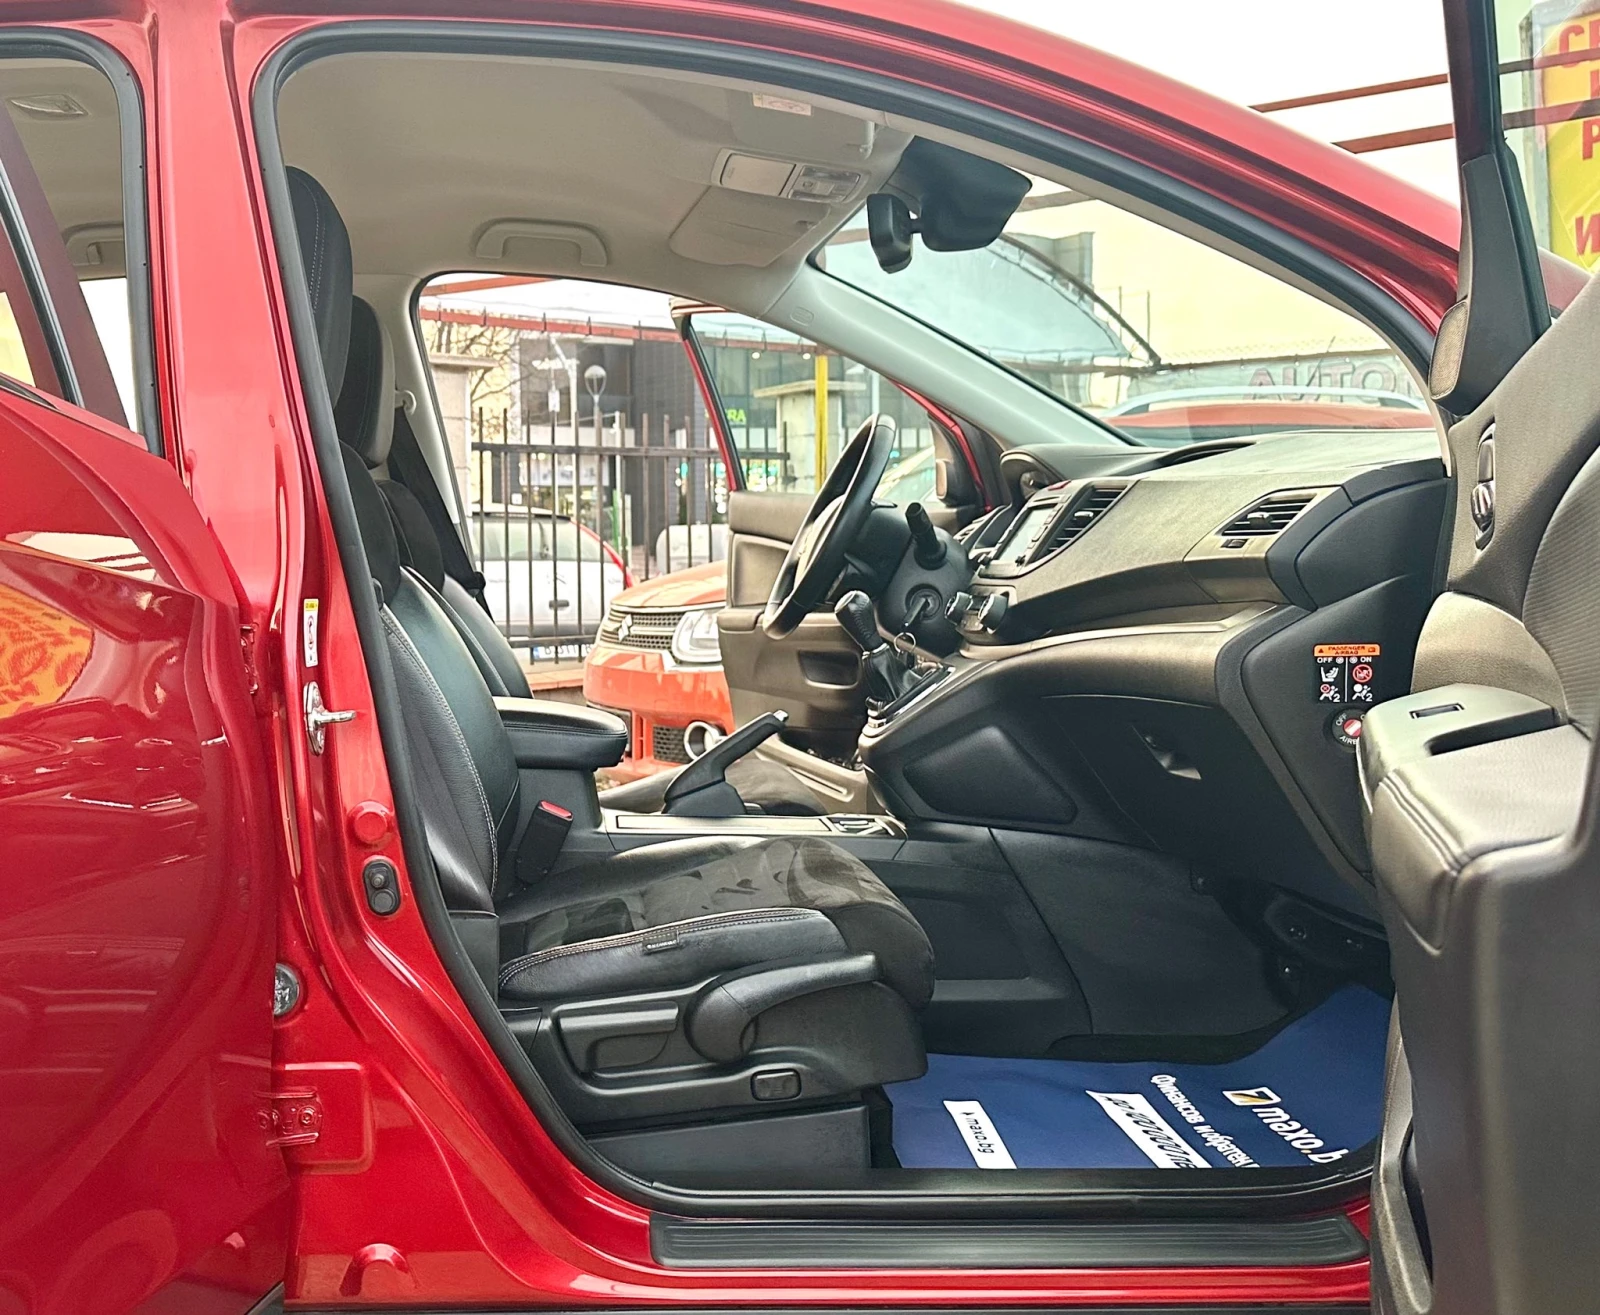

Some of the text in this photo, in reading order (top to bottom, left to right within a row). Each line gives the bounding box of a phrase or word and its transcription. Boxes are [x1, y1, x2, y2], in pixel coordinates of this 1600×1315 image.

[1336, 714, 1347, 725] OFF
[1340, 736, 1357, 744] AIRB
[1150, 1074, 1205, 1124] Финансов
[965, 1117, 995, 1154] maxo.bg
